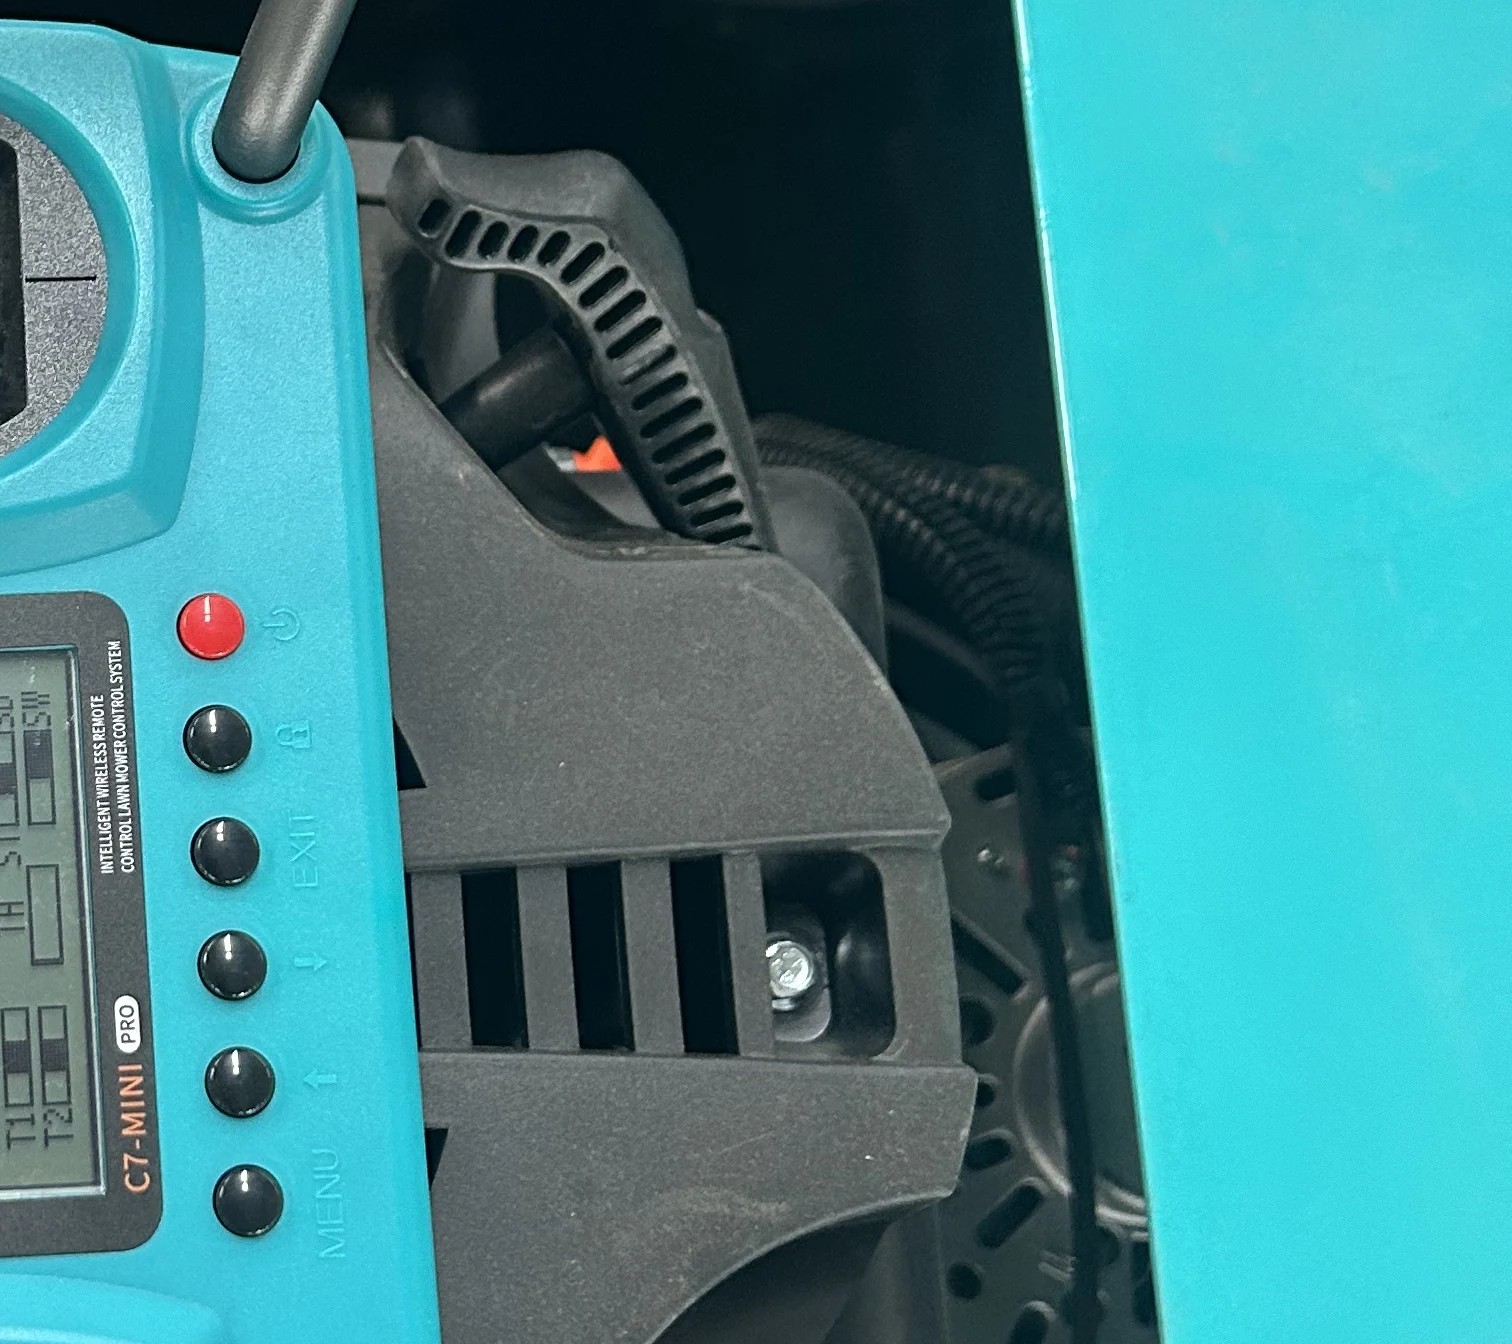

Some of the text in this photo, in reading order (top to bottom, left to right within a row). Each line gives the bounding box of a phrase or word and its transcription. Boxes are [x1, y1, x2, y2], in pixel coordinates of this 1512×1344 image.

[21, 691, 51, 727] SW
[89, 695, 115, 874] INTELLIGENT WIRELESS REMOTE
[107, 641, 136, 873] CONTROL LAWN MOWER CONTROL SYSTEM
[289, 811, 320, 889] EXIT
[5, 1113, 36, 1150] T1
[43, 1107, 74, 1148] T2
[117, 1004, 151, 1193] C7-MINI PRO
[311, 1147, 346, 1258] MENU
